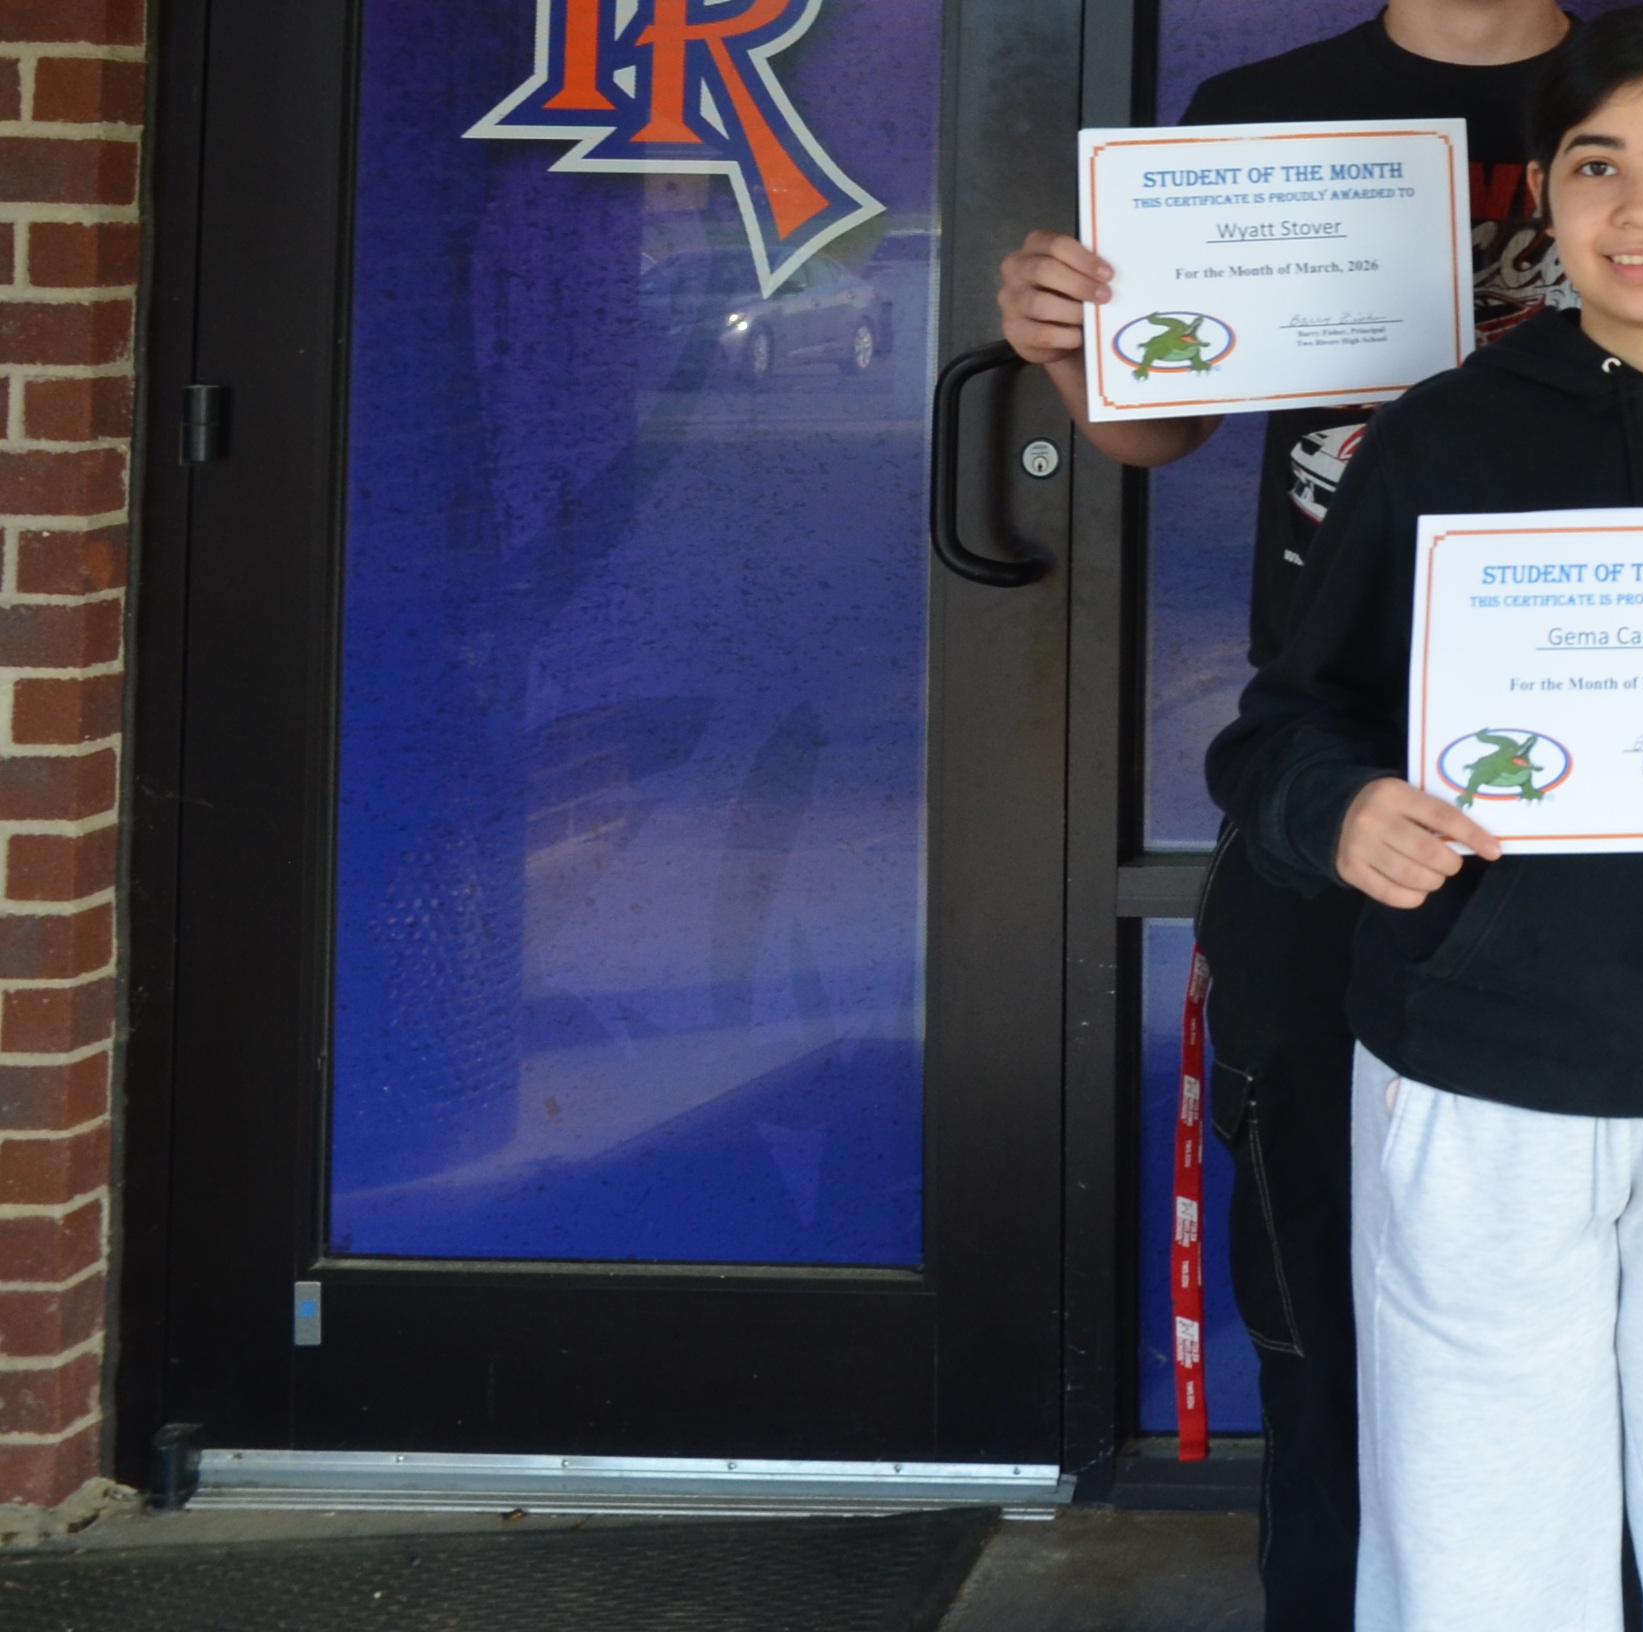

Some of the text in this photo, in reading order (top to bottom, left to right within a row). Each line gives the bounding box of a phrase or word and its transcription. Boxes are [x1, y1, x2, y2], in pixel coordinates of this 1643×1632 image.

[1143, 162, 1403, 188] STUDENT OF THE MONTH
[1133, 188, 1415, 209] THIS CERTIFICATE IS PROUDLY AWARDED TO
[1217, 220, 1343, 241] Wyatt Stover
[1176, 259, 1379, 280] For the Month of March, 2026
[1482, 565, 1588, 584] STUDENT
[1594, 564, 1624, 582] OF
[1470, 596, 1501, 607] THIS
[1504, 594, 1595, 606] CERTIFICATE
[1599, 594, 1612, 606] IS
[1548, 628, 1609, 646] Gema
[1510, 678, 1536, 691] For
[1541, 678, 1564, 691] the
[1569, 677, 1619, 691] Month
[1623, 676, 1639, 690] of
